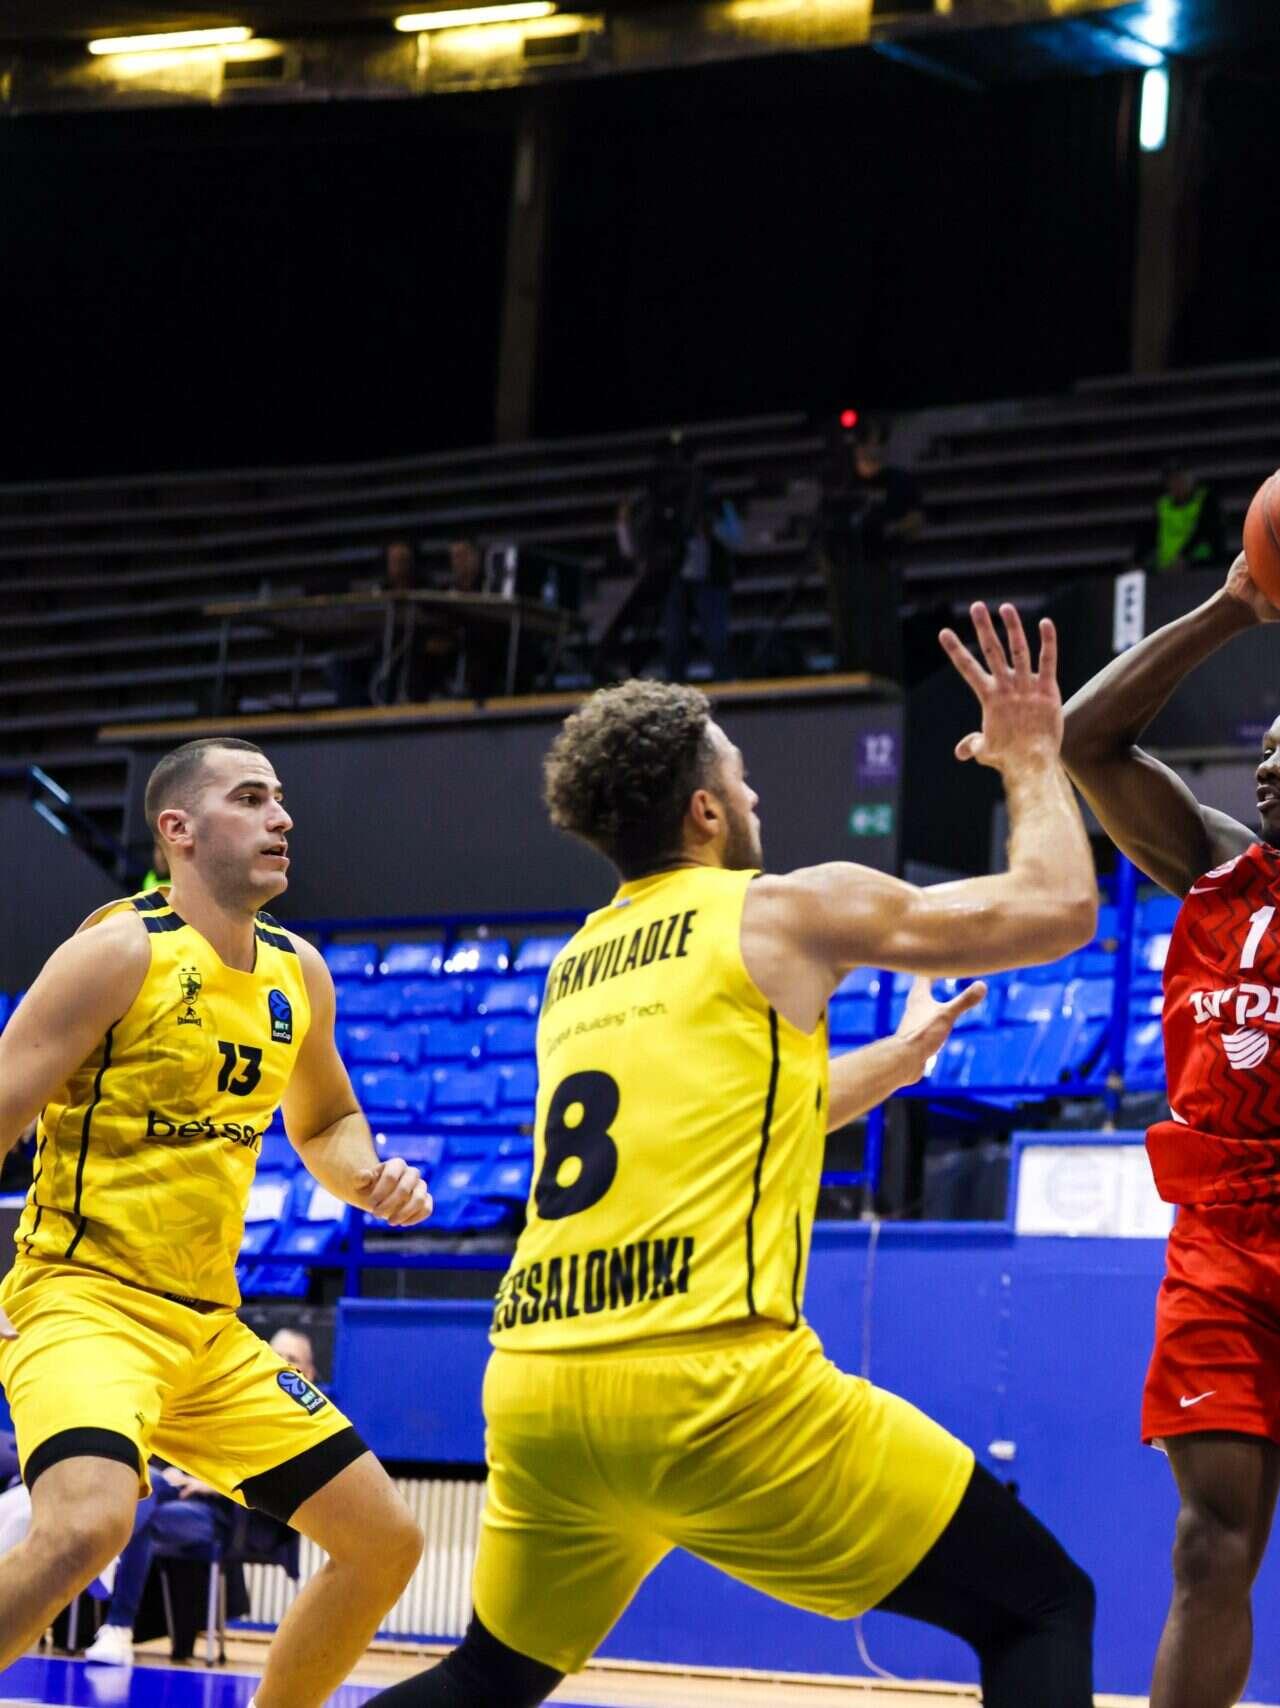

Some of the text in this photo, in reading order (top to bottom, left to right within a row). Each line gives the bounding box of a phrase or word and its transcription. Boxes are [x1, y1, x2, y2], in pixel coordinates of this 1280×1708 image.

[1239, 905, 1277, 969] 1
[217, 1040, 263, 1097] 13
[534, 1069, 621, 1221] 8
